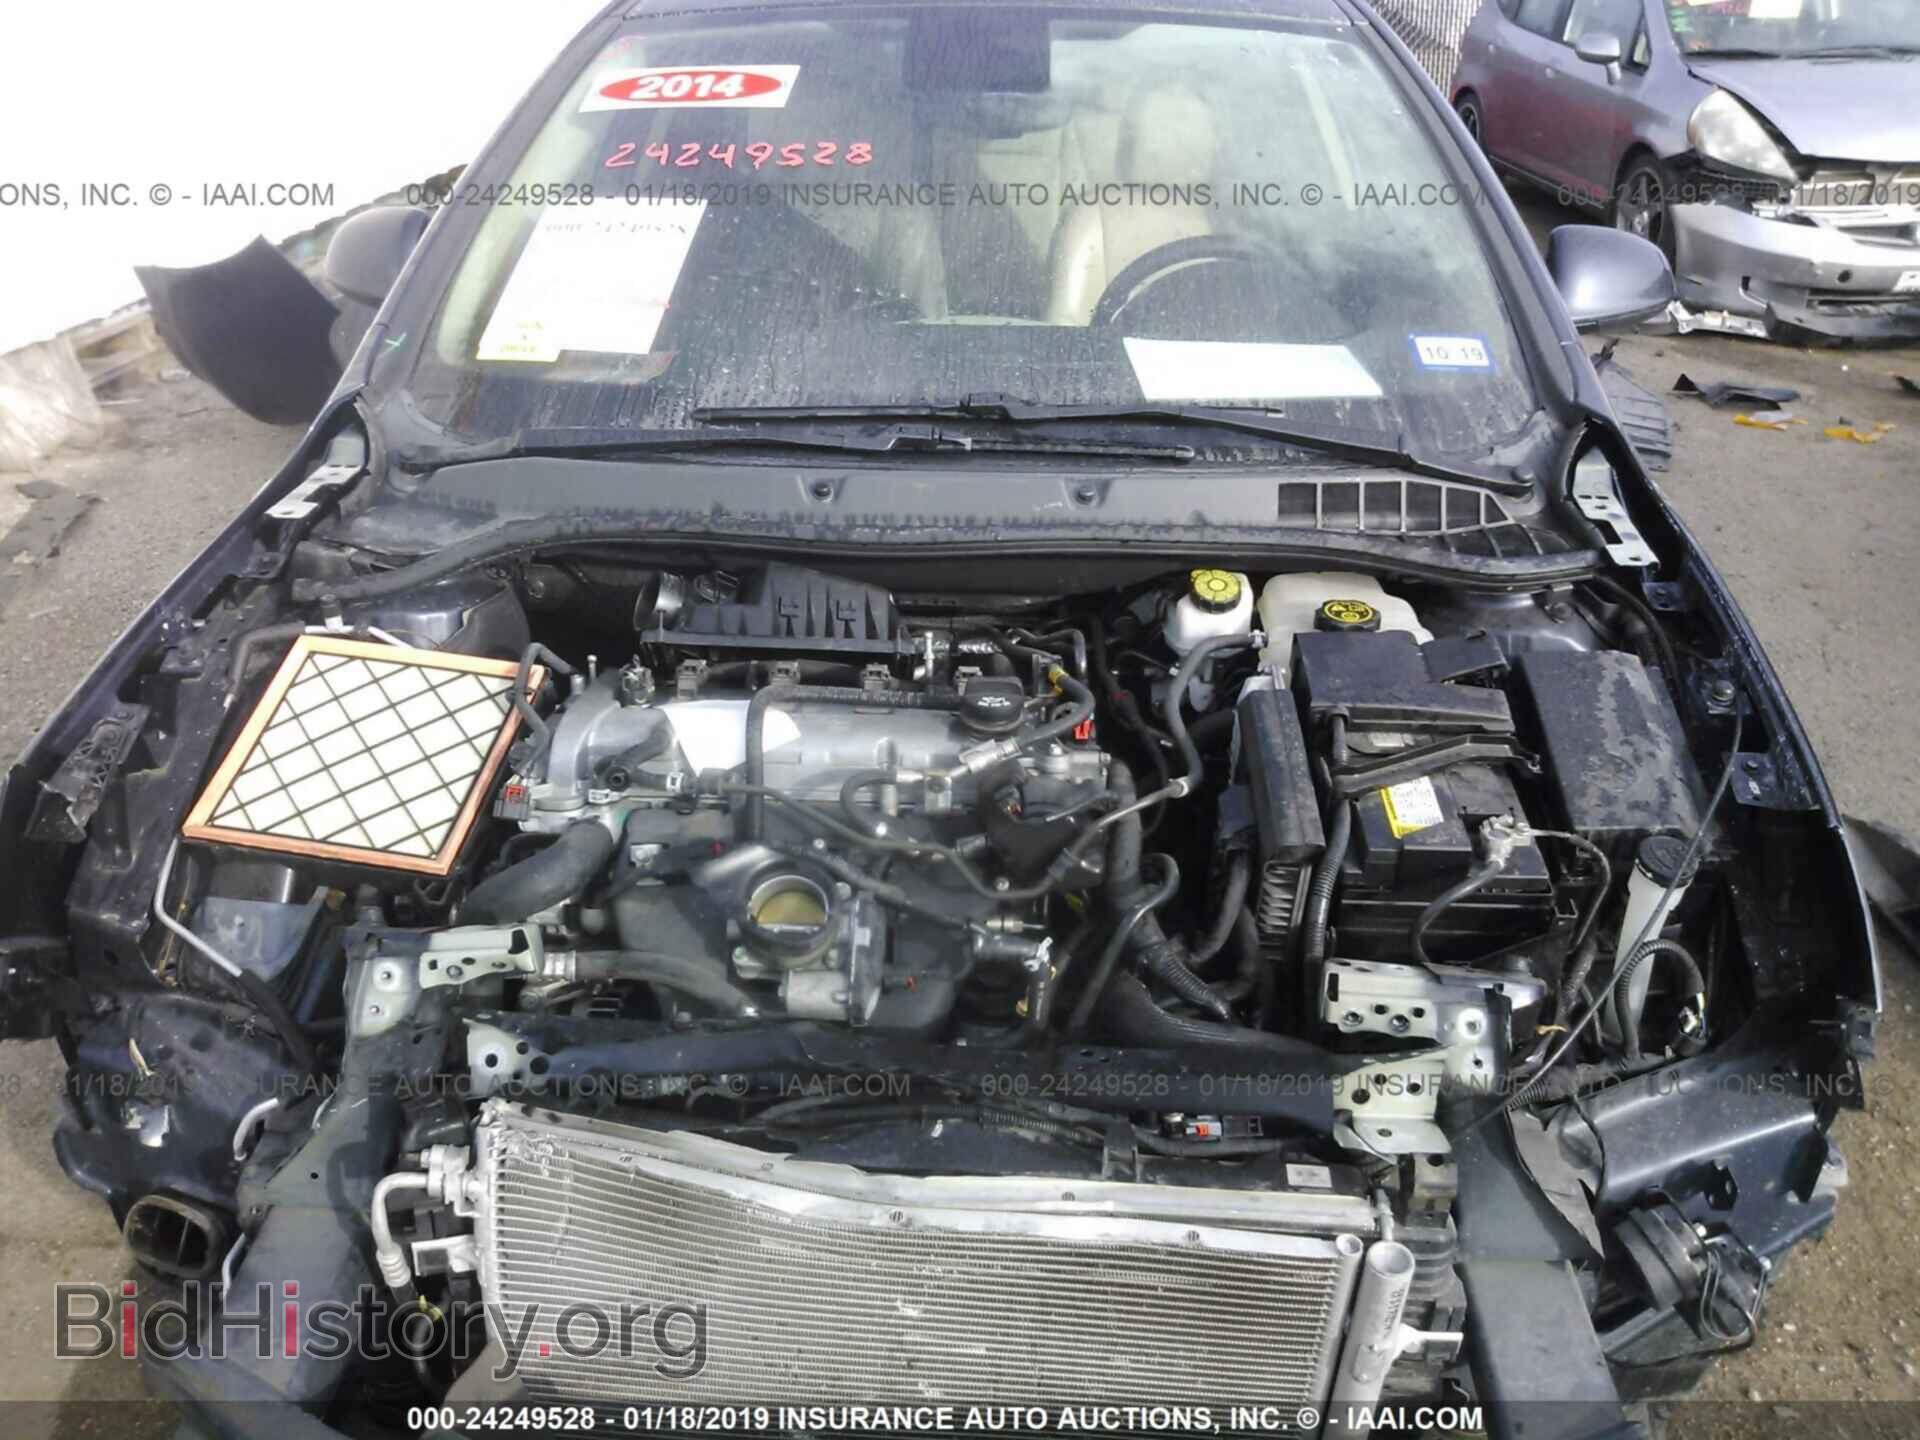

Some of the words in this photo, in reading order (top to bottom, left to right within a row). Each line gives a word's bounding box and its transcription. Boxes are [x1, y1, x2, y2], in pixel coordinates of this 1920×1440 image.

[629, 73, 745, 99] 2014
[604, 142, 874, 171] 24249528
[1460, 346, 1484, 361] 19
